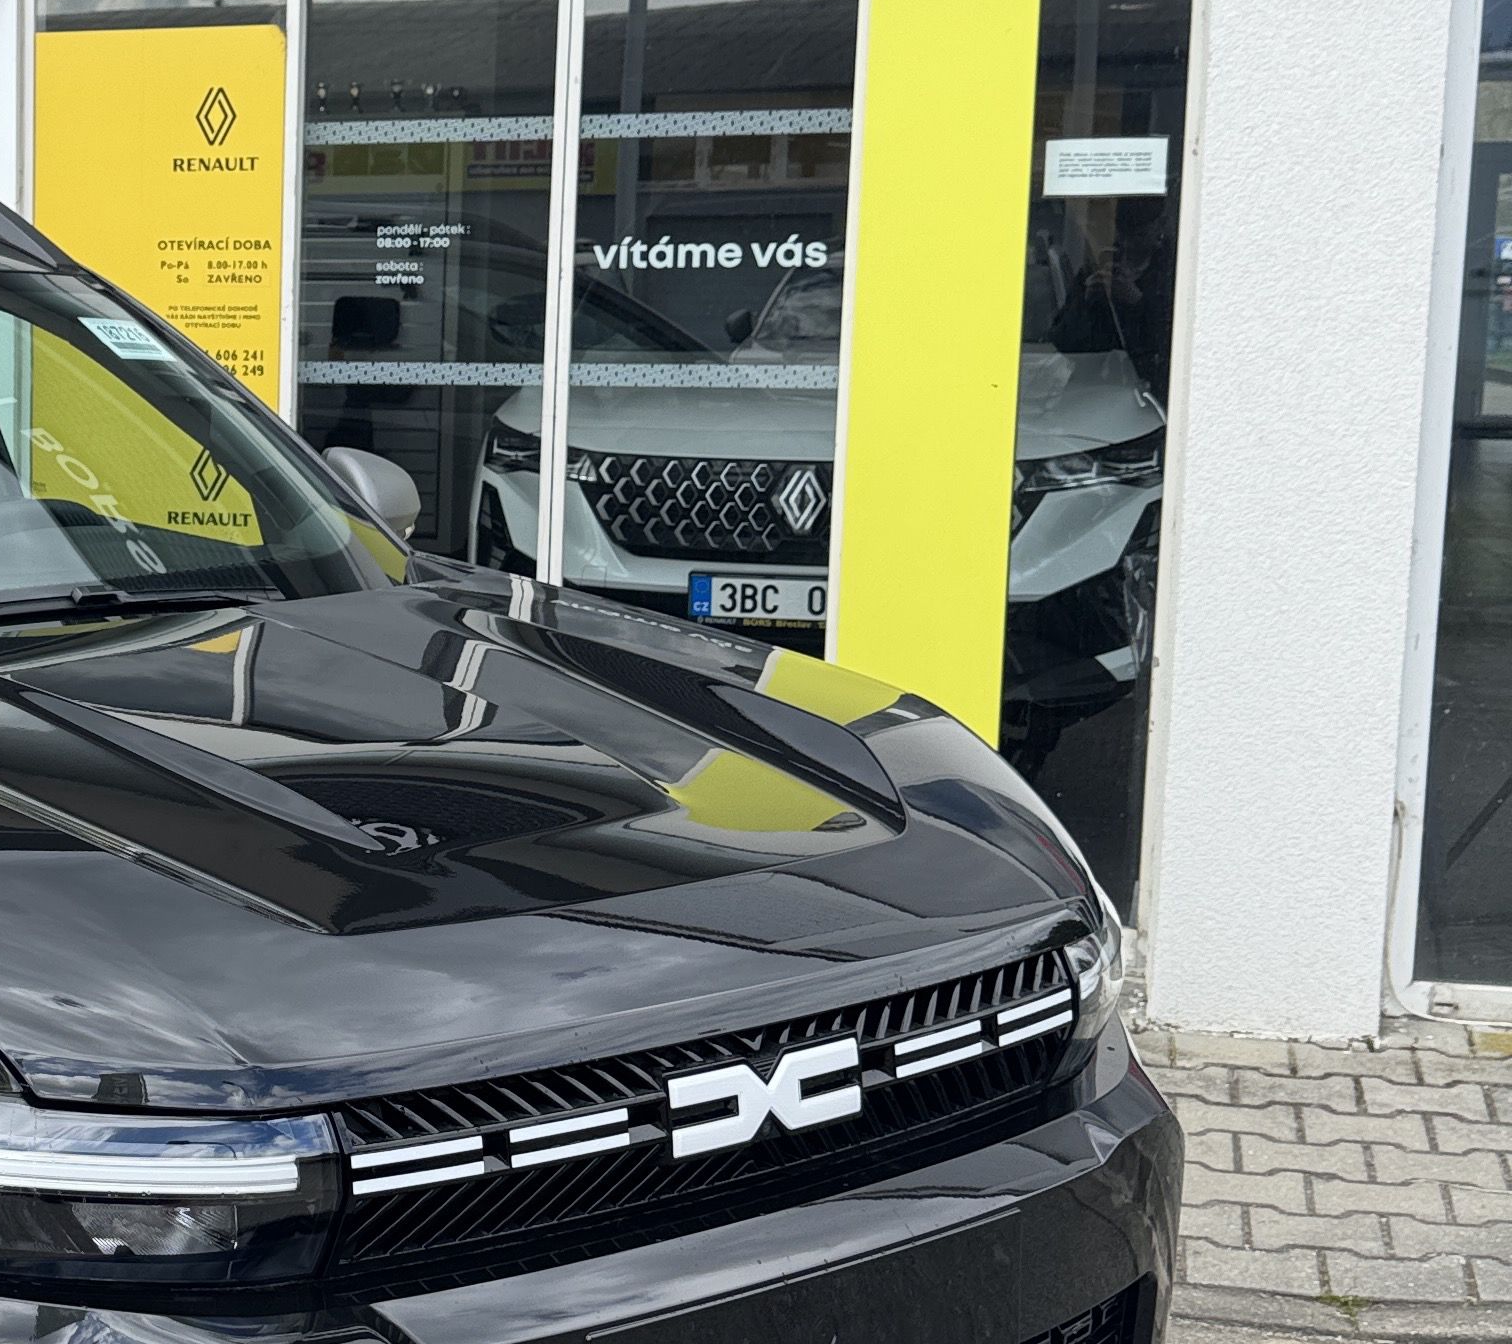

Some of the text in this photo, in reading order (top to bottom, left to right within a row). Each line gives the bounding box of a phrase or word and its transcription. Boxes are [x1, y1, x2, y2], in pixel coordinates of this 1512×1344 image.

[172, 157, 260, 172] RENAULT
[157, 236, 272, 251] OTEVÍRACÍ DOBA
[593, 233, 828, 269] vítáme vás
[207, 272, 262, 284] ZAVŘENO
[375, 273, 425, 285] zavřeno
[215, 349, 238, 361] 606
[242, 349, 264, 361] 241
[242, 364, 264, 376] 249
[167, 510, 252, 527] RENAULT
[719, 582, 779, 614] 3BC
[693, 601, 709, 612] CZ
